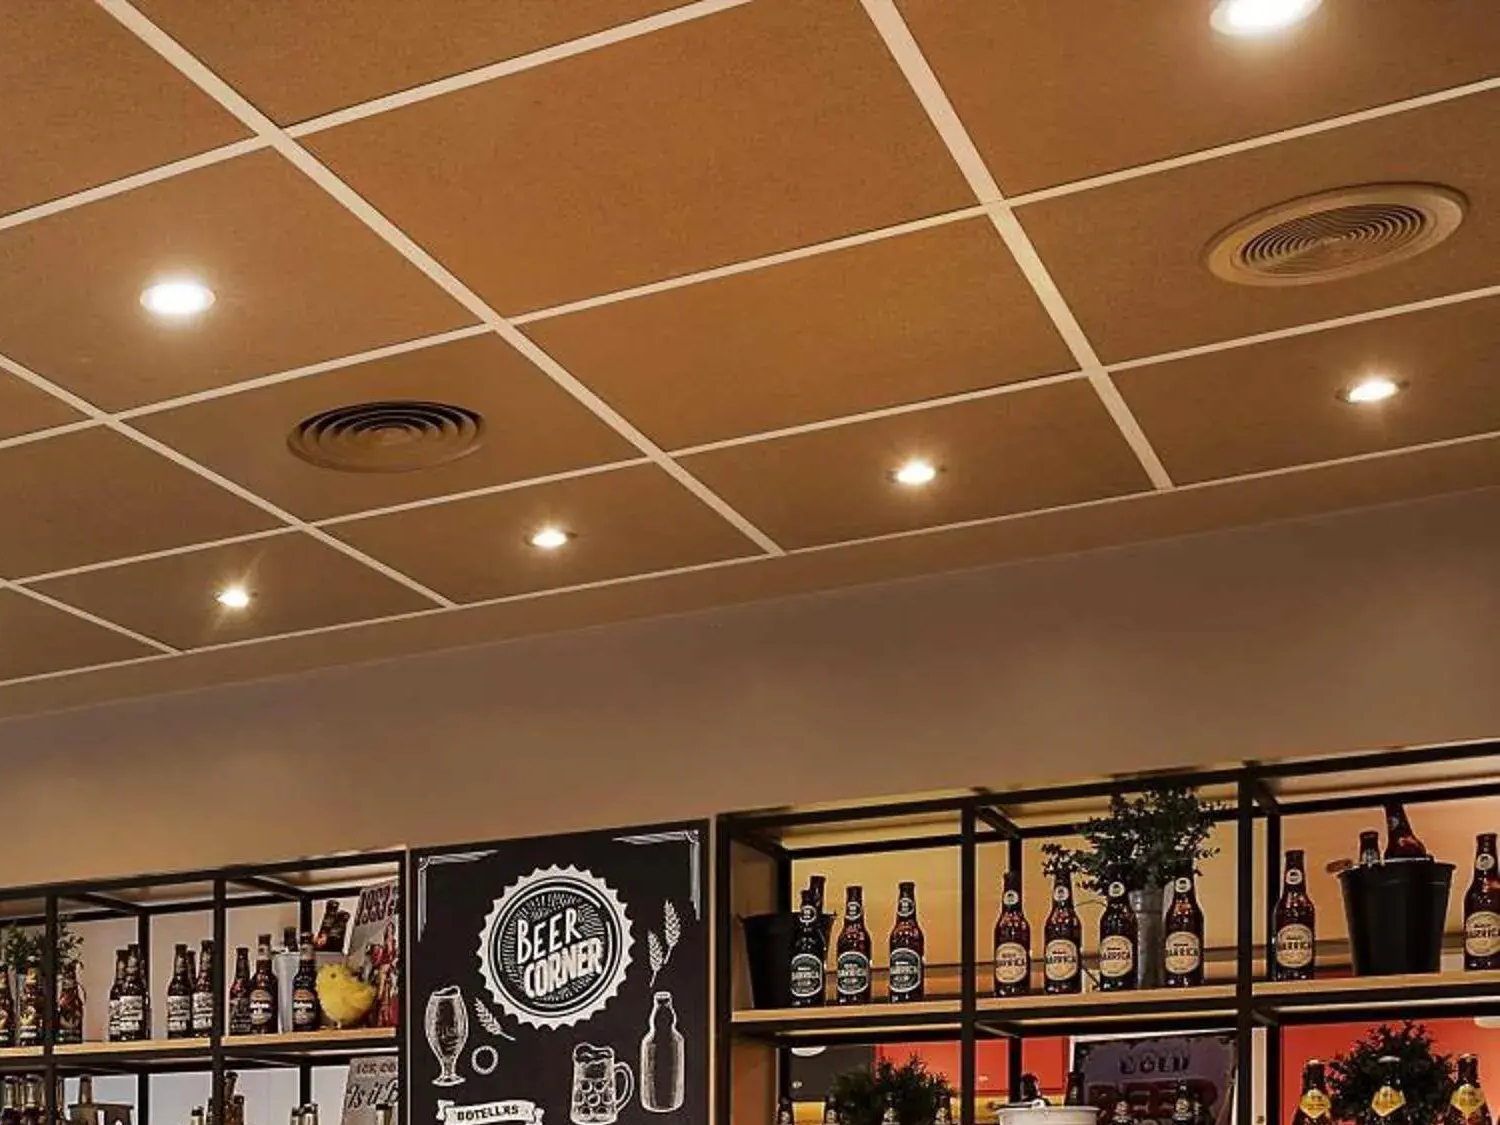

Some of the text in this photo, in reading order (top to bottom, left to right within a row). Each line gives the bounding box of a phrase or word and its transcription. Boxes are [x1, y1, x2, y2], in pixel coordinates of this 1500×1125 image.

[517, 908, 582, 964] BEER
[523, 937, 603, 999] CORNER
[456, 1105, 520, 1123] BOTELLAS
